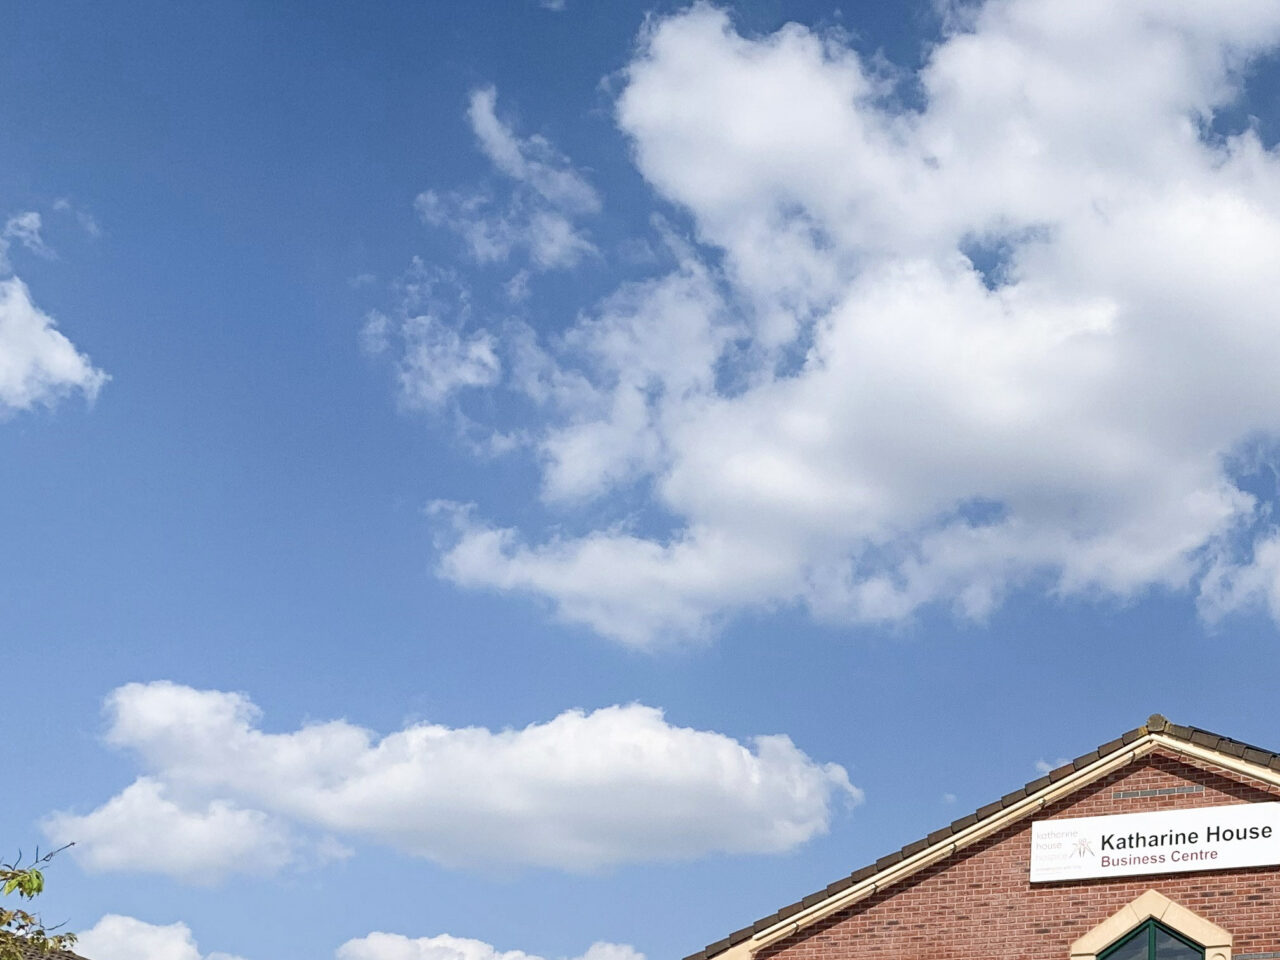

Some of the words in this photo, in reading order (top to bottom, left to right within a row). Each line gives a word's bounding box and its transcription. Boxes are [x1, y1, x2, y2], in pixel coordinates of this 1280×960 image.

[1036, 842, 1062, 850] house
[1101, 829, 1199, 850] Katharine
[1206, 825, 1272, 842] House
[1101, 851, 1165, 867] Business
[1171, 849, 1218, 862] Centre
